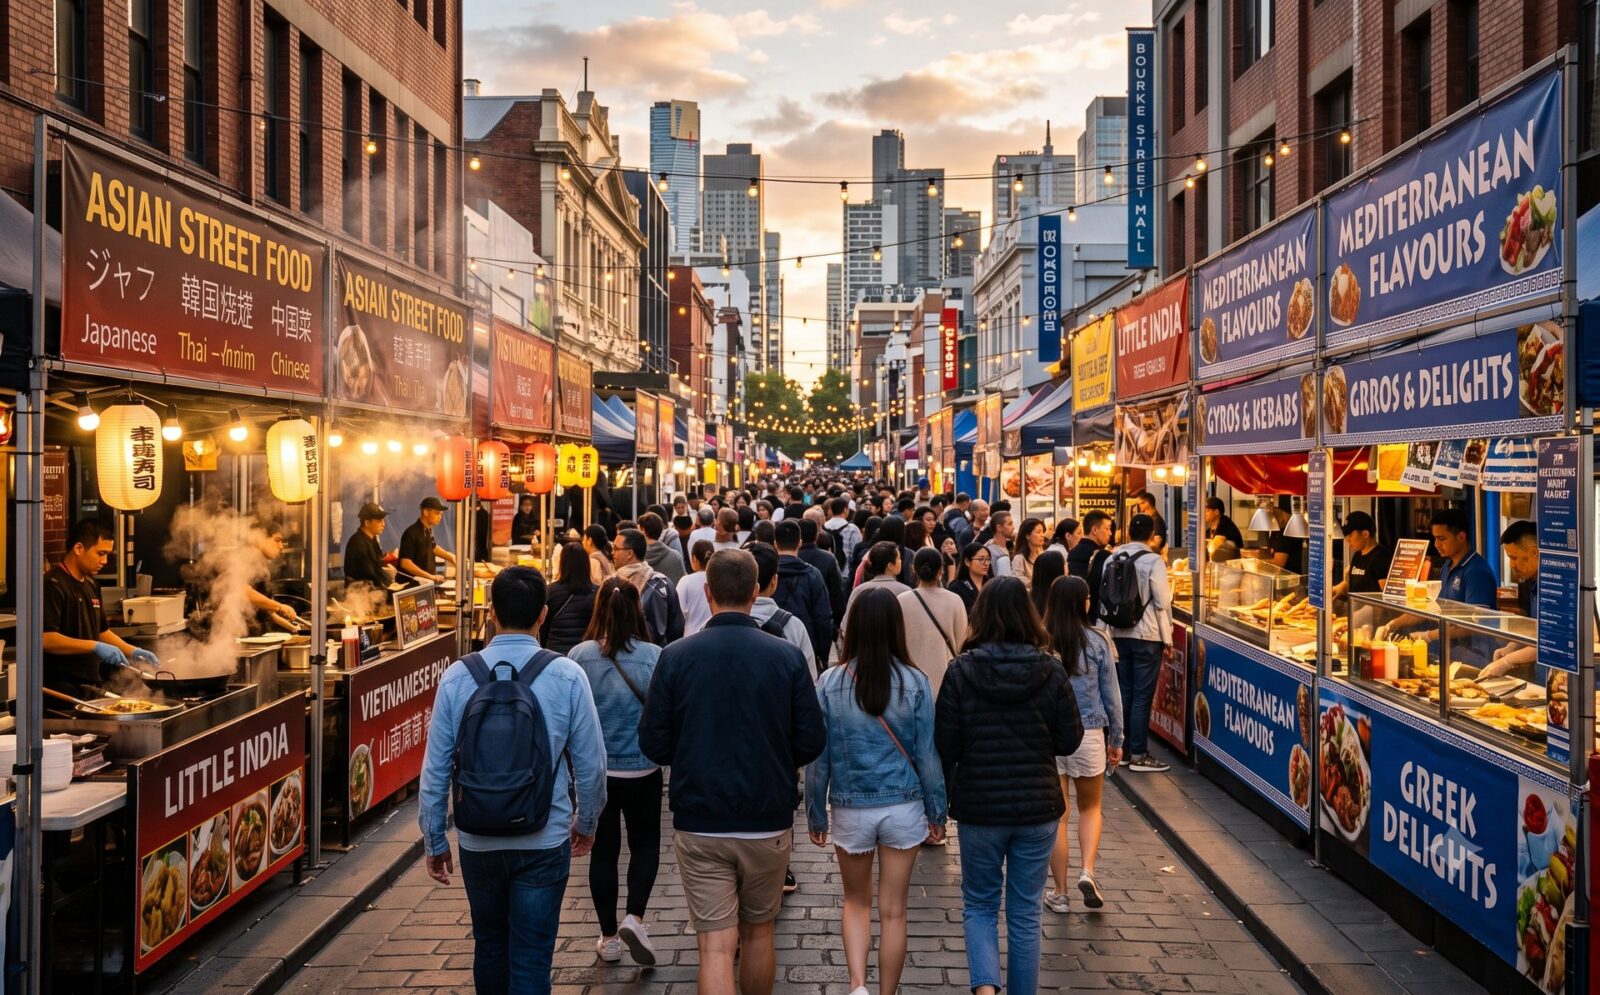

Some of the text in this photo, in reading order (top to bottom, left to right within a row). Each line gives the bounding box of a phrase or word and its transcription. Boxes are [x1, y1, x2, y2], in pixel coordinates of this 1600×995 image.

[1135, 43, 1147, 253] BOURKE STREET MALL
[1338, 118, 1535, 258] MEDITERRANEAN
[85, 171, 313, 293] ASIAN STREET FOOD
[1369, 209, 1486, 298] FLAVOURS
[343, 271, 464, 343] ASIAN STREET FOOD
[1203, 233, 1307, 313] MEDITERRANEAN
[81, 313, 157, 354] Japanese
[178, 331, 207, 364] Thai
[271, 351, 310, 380] Chinese
[271, 299, 312, 343] 中国菜
[1150, 301, 1183, 346] INDIA
[1221, 290, 1281, 345] FLAVOURS
[1207, 391, 1298, 435] GYROS & KEBABS
[1350, 351, 1513, 417] GRROS & DELIGHTS
[360, 665, 430, 722] VIETNAMESE
[1208, 663, 1295, 733] MEDITERRANEAN
[1224, 702, 1275, 757] FLAVOURS
[165, 722, 289, 818] LITTLE INDIA
[1400, 760, 1477, 839] GREEK
[1383, 799, 1498, 910] DELIGHTS
